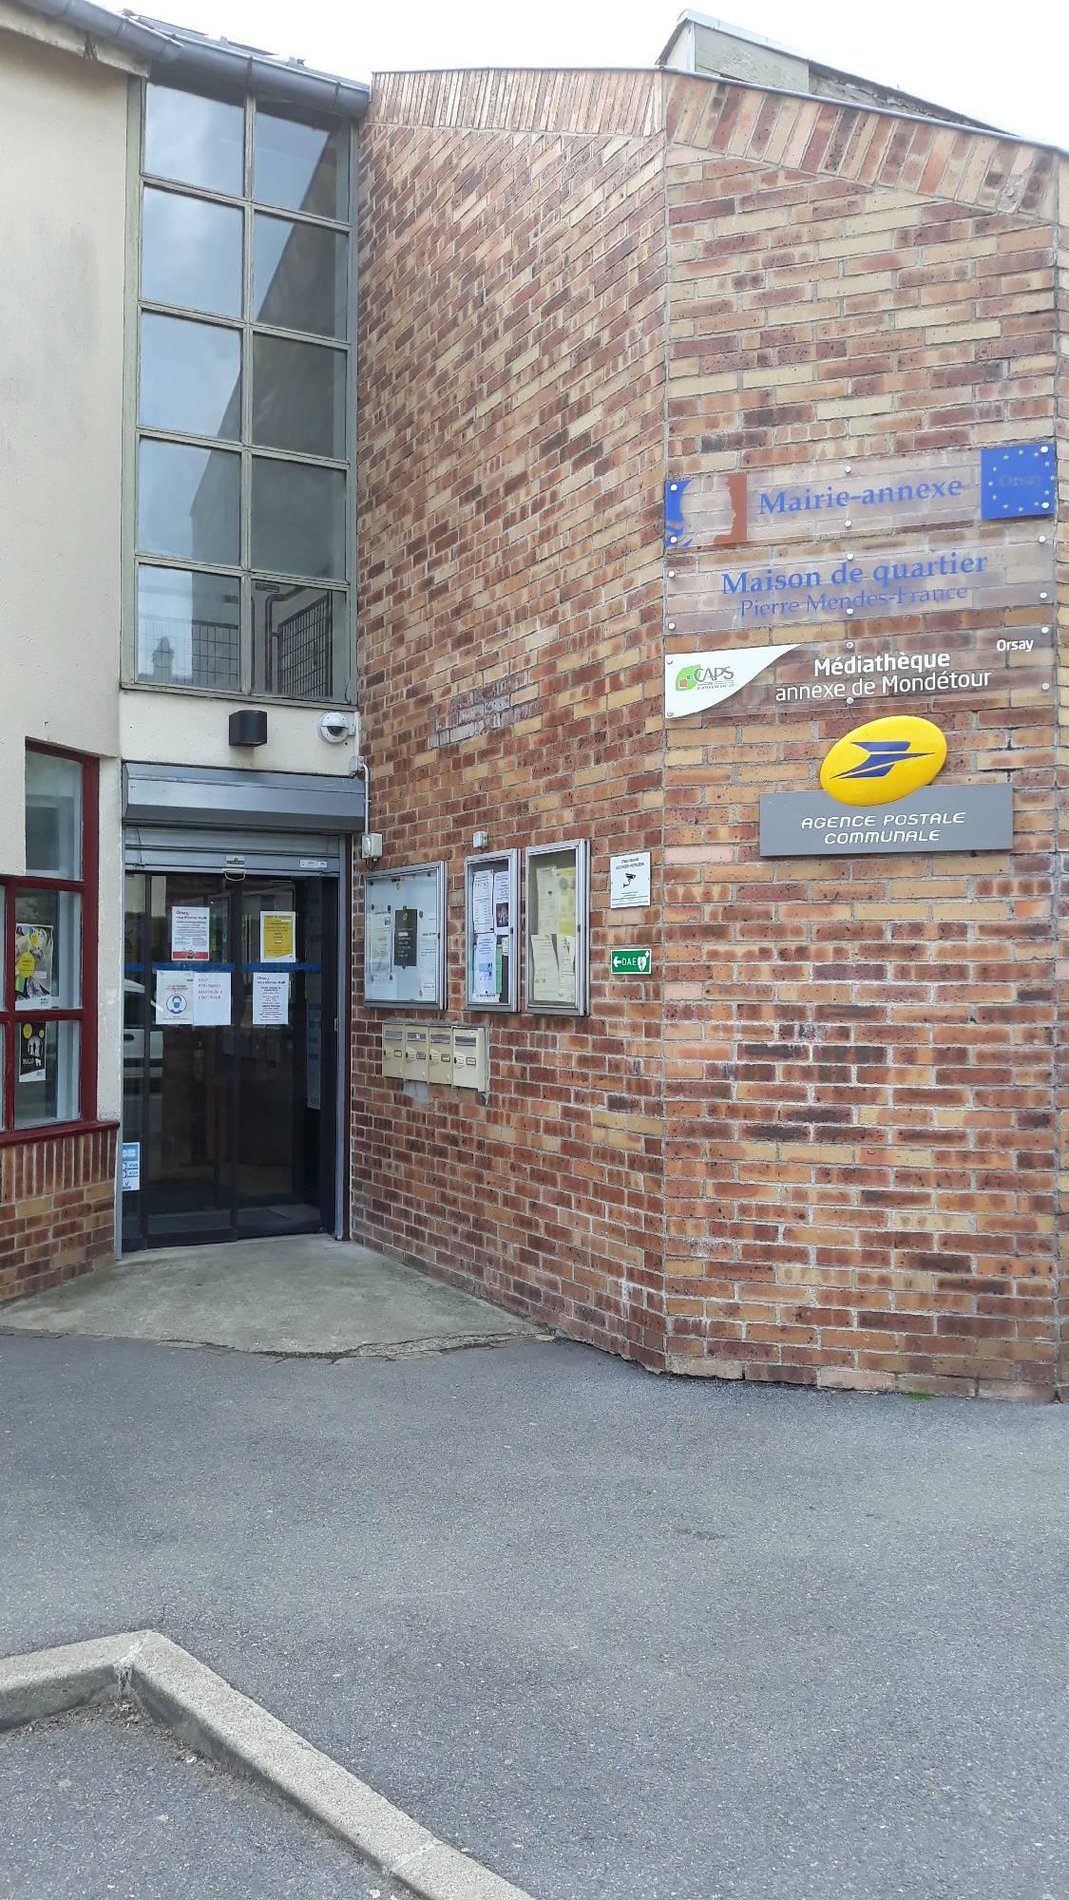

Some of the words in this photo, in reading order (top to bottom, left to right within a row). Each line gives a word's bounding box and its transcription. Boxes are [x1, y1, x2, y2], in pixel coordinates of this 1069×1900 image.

[759, 479, 963, 514] Mairie-annexe
[721, 568, 821, 594] Maison
[831, 561, 864, 587] de
[873, 552, 988, 588] quartier
[740, 599, 801, 618] Pierre
[807, 586, 968, 612] Mendes-France
[996, 638, 1034, 652] Orsay
[694, 666, 734, 682] CAPS
[814, 651, 950, 677] Médiathèque
[775, 681, 846, 701] annexe
[851, 678, 875, 696] de
[882, 670, 991, 694] Mondétour
[801, 815, 876, 829] AGENCE
[884, 811, 966, 826] POSTALE
[824, 829, 941, 845] COMMUNALE
[621, 957, 637, 966] DAE
